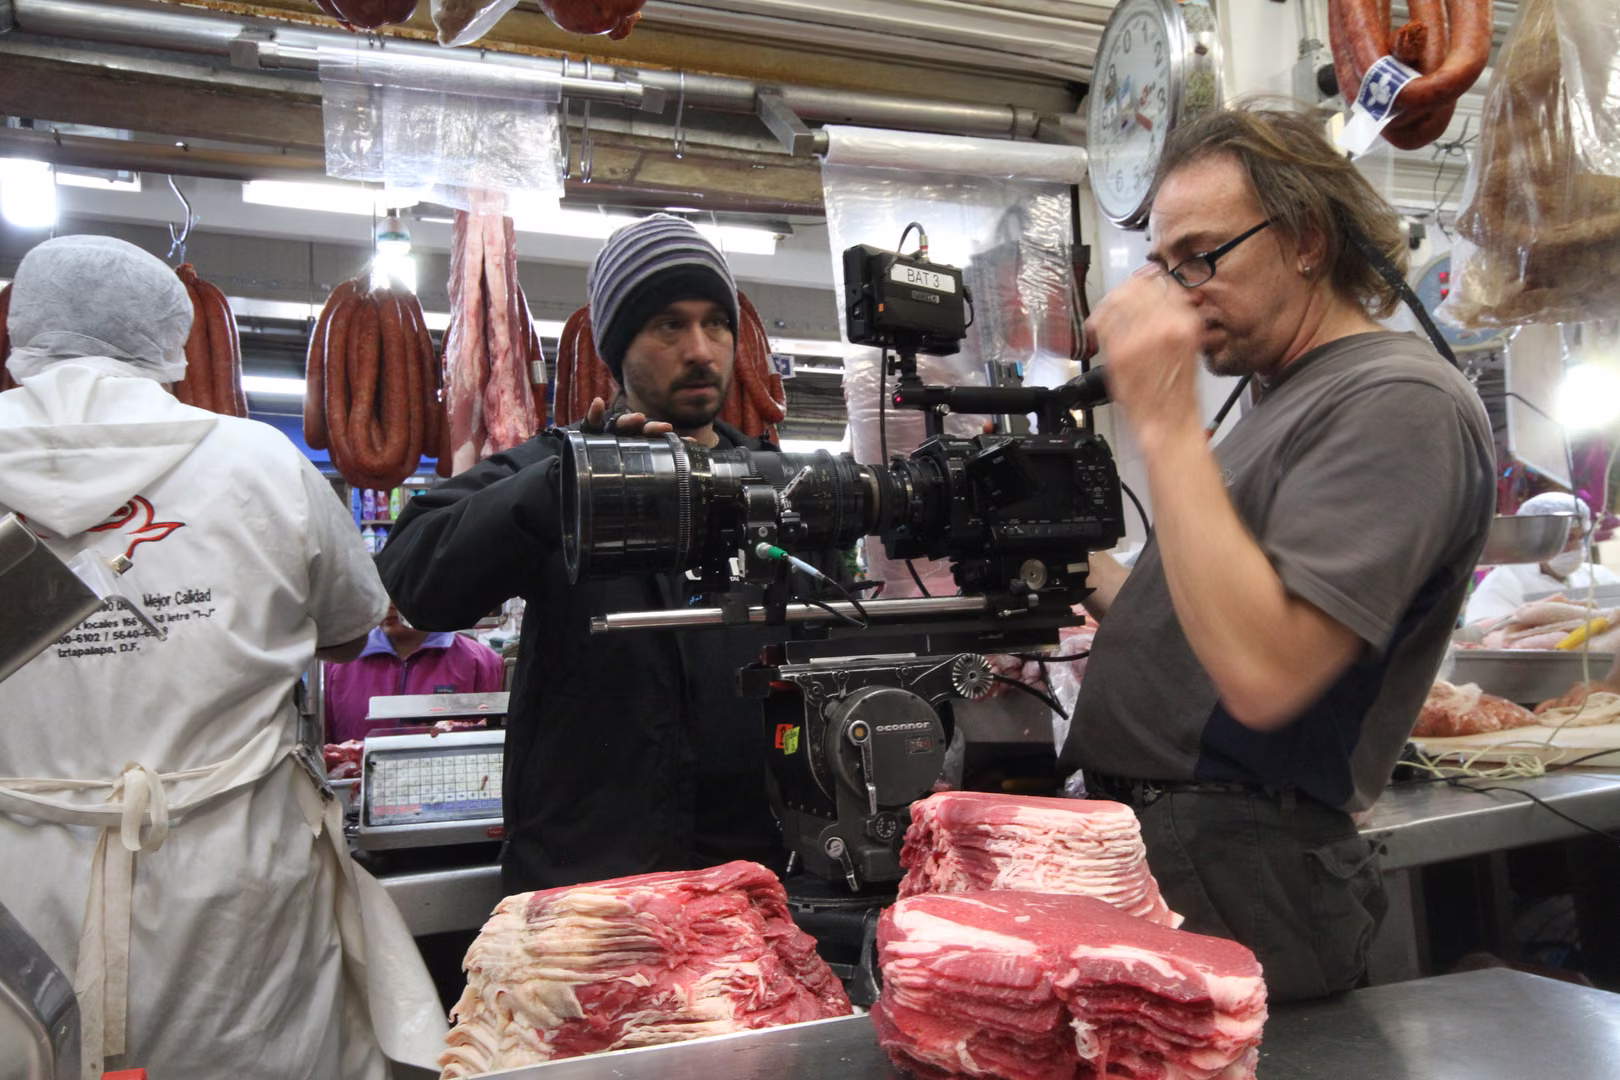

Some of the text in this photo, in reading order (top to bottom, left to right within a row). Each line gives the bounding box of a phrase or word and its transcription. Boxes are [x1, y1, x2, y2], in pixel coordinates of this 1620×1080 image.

[1123, 29, 1132, 54] 0
[907, 268, 940, 288] BAT 3
[142, 593, 171, 611] Mejor
[175, 588, 212, 605] Calidad
[84, 619, 119, 630] locales
[58, 642, 141, 658] Iztapalapa, D.F.
